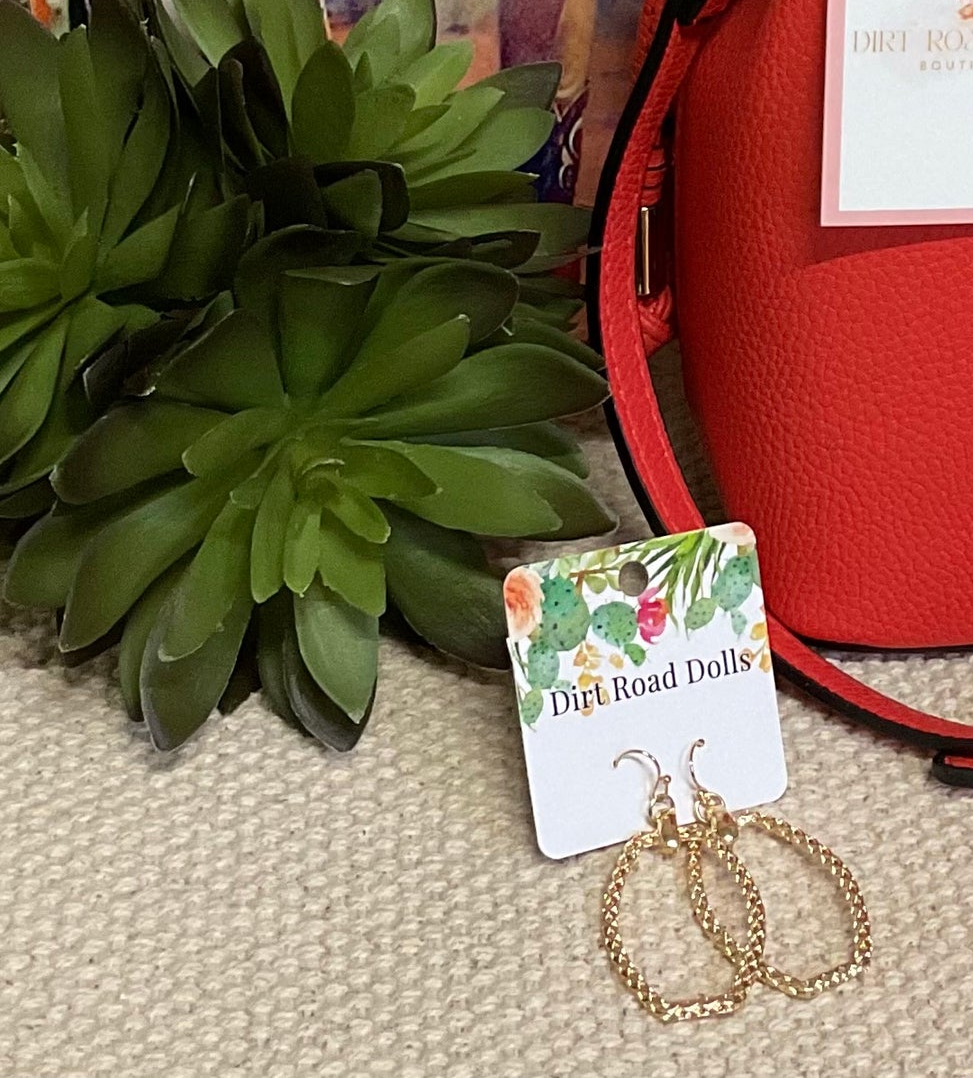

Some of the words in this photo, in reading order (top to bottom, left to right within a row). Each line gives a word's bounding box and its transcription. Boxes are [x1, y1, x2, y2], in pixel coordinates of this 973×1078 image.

[853, 30, 908, 52] DIRT
[550, 683, 606, 717] Dirt
[612, 662, 678, 702] Road
[685, 648, 751, 684] Dolls
